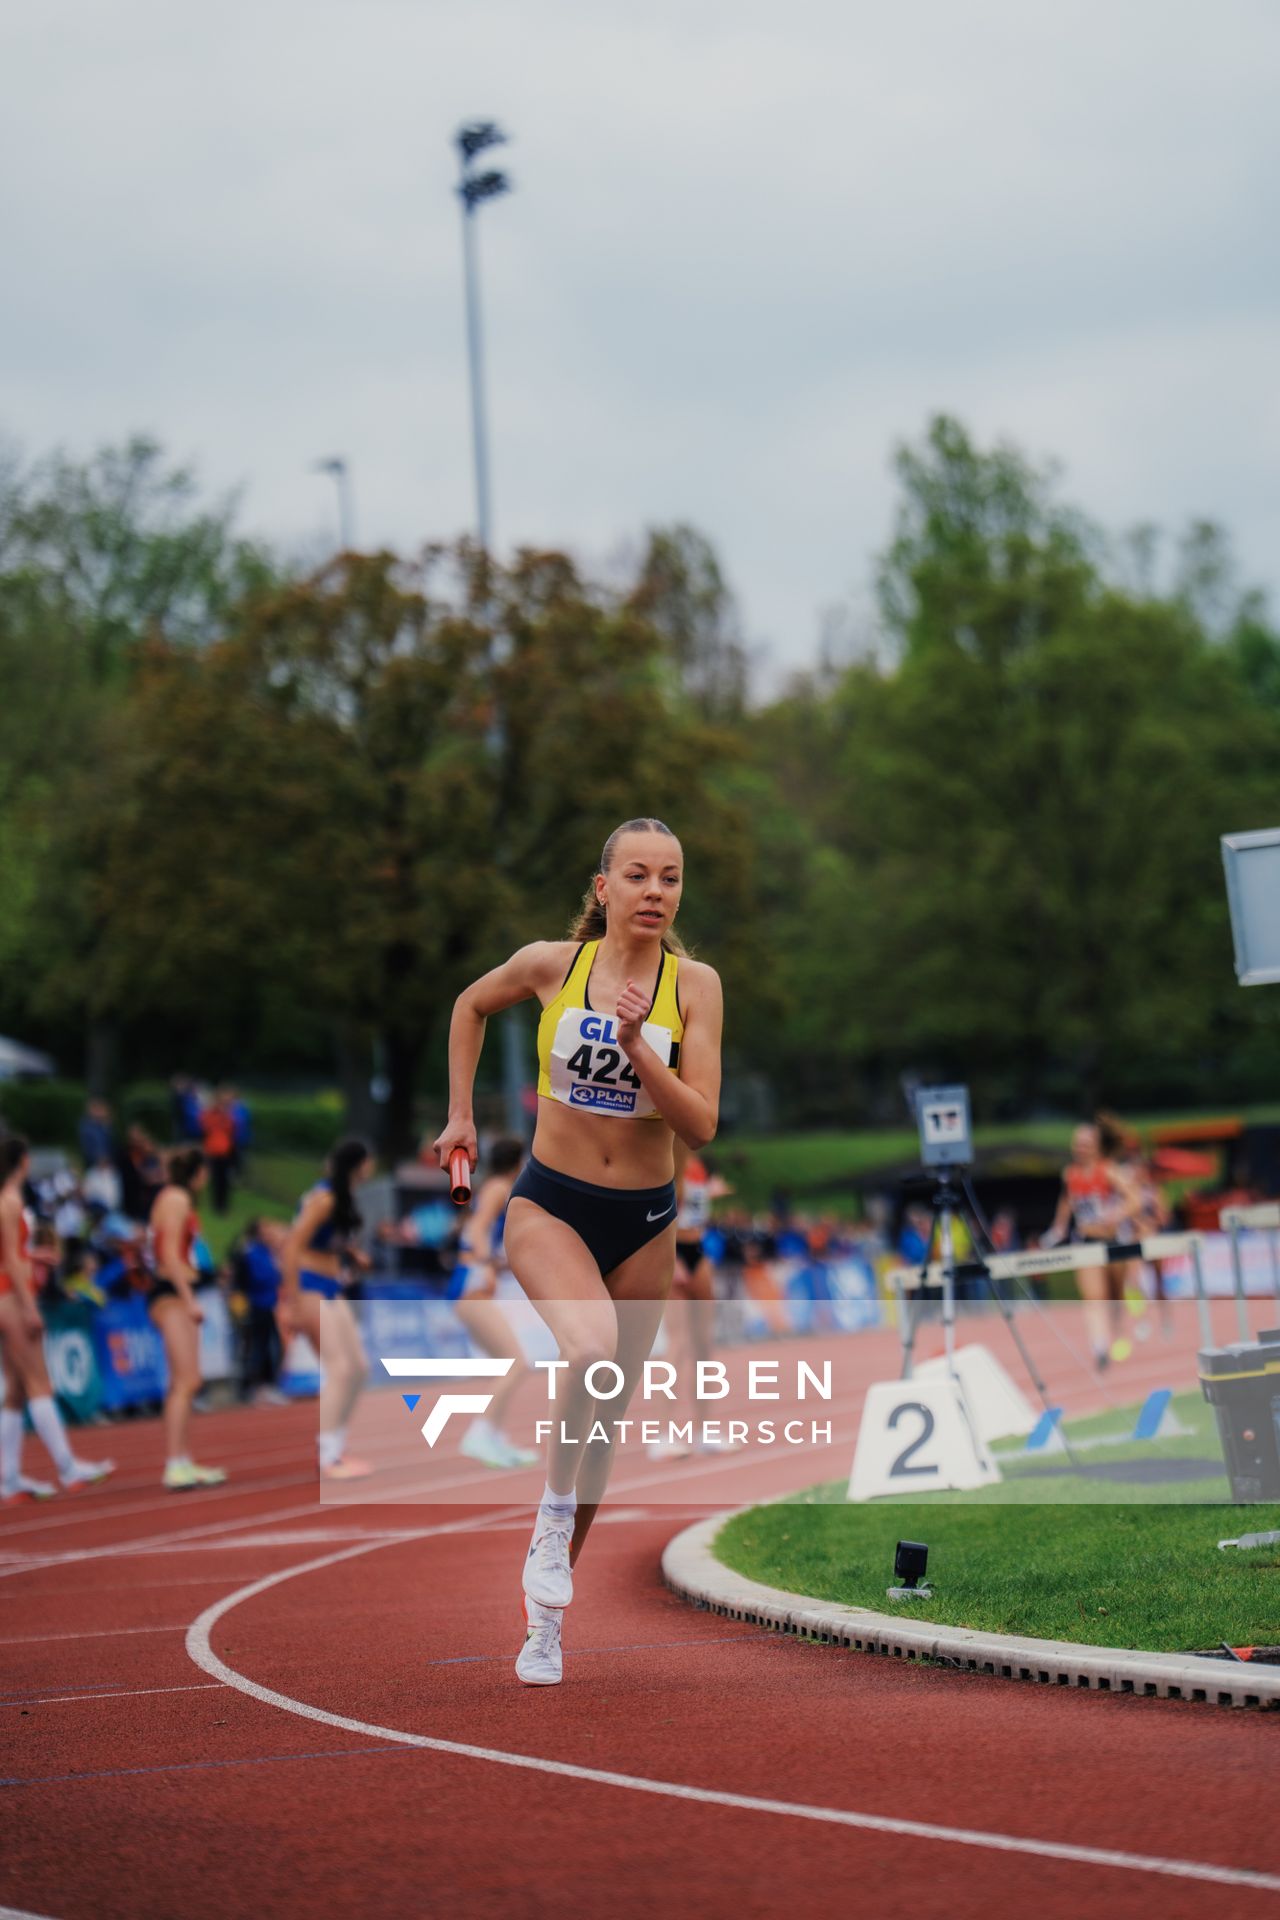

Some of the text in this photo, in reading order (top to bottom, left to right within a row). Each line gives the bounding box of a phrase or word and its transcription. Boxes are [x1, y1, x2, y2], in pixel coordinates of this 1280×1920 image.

[580, 1017, 618, 1045] GL
[567, 1044, 641, 1089] 424
[597, 1090, 633, 1104] PLAN
[887, 1402, 938, 1477] 2
